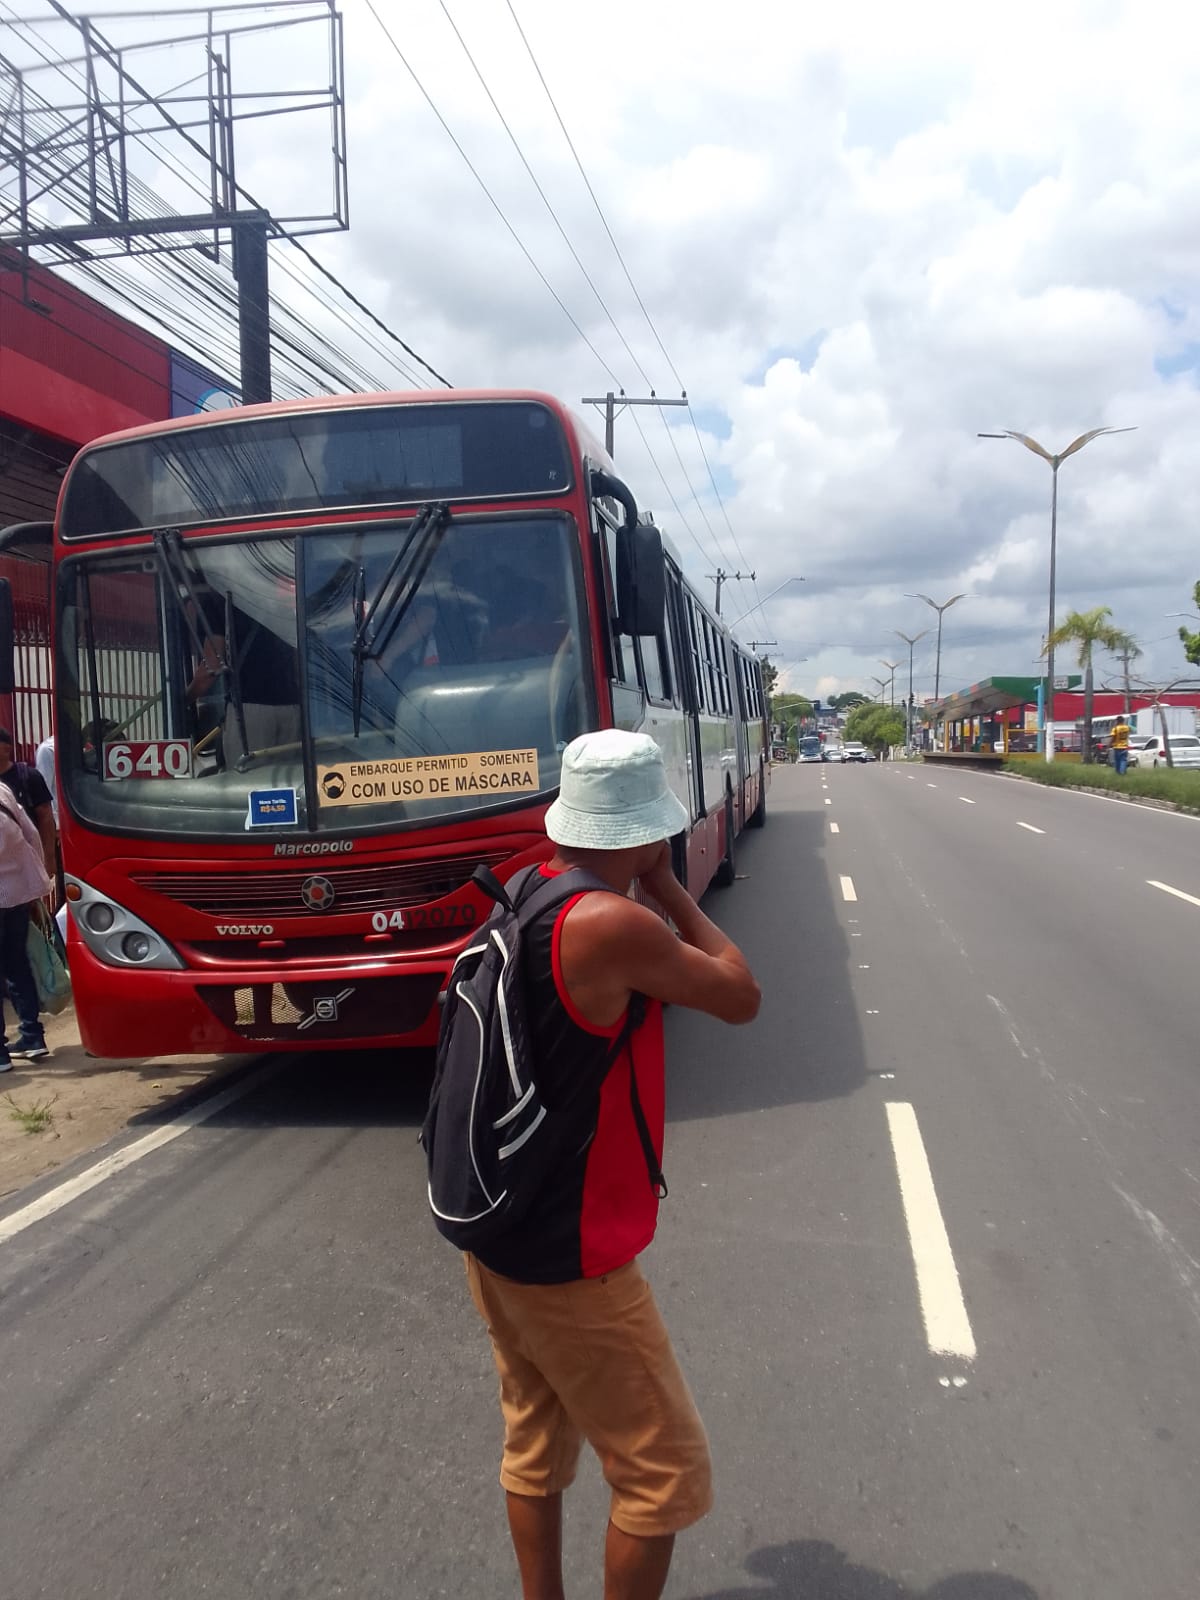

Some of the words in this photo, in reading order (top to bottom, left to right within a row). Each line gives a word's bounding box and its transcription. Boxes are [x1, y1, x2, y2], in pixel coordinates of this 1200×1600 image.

[108, 743, 188, 778] 640
[350, 761, 413, 777] EMBARQUE
[480, 752, 534, 767] SOMENTE
[351, 781, 386, 798] COM
[391, 779, 424, 796] USO
[429, 777, 450, 793] DE
[455, 771, 533, 791] MÁSCARA
[273, 839, 354, 856] Marcopolo
[215, 924, 274, 936] VOLVO
